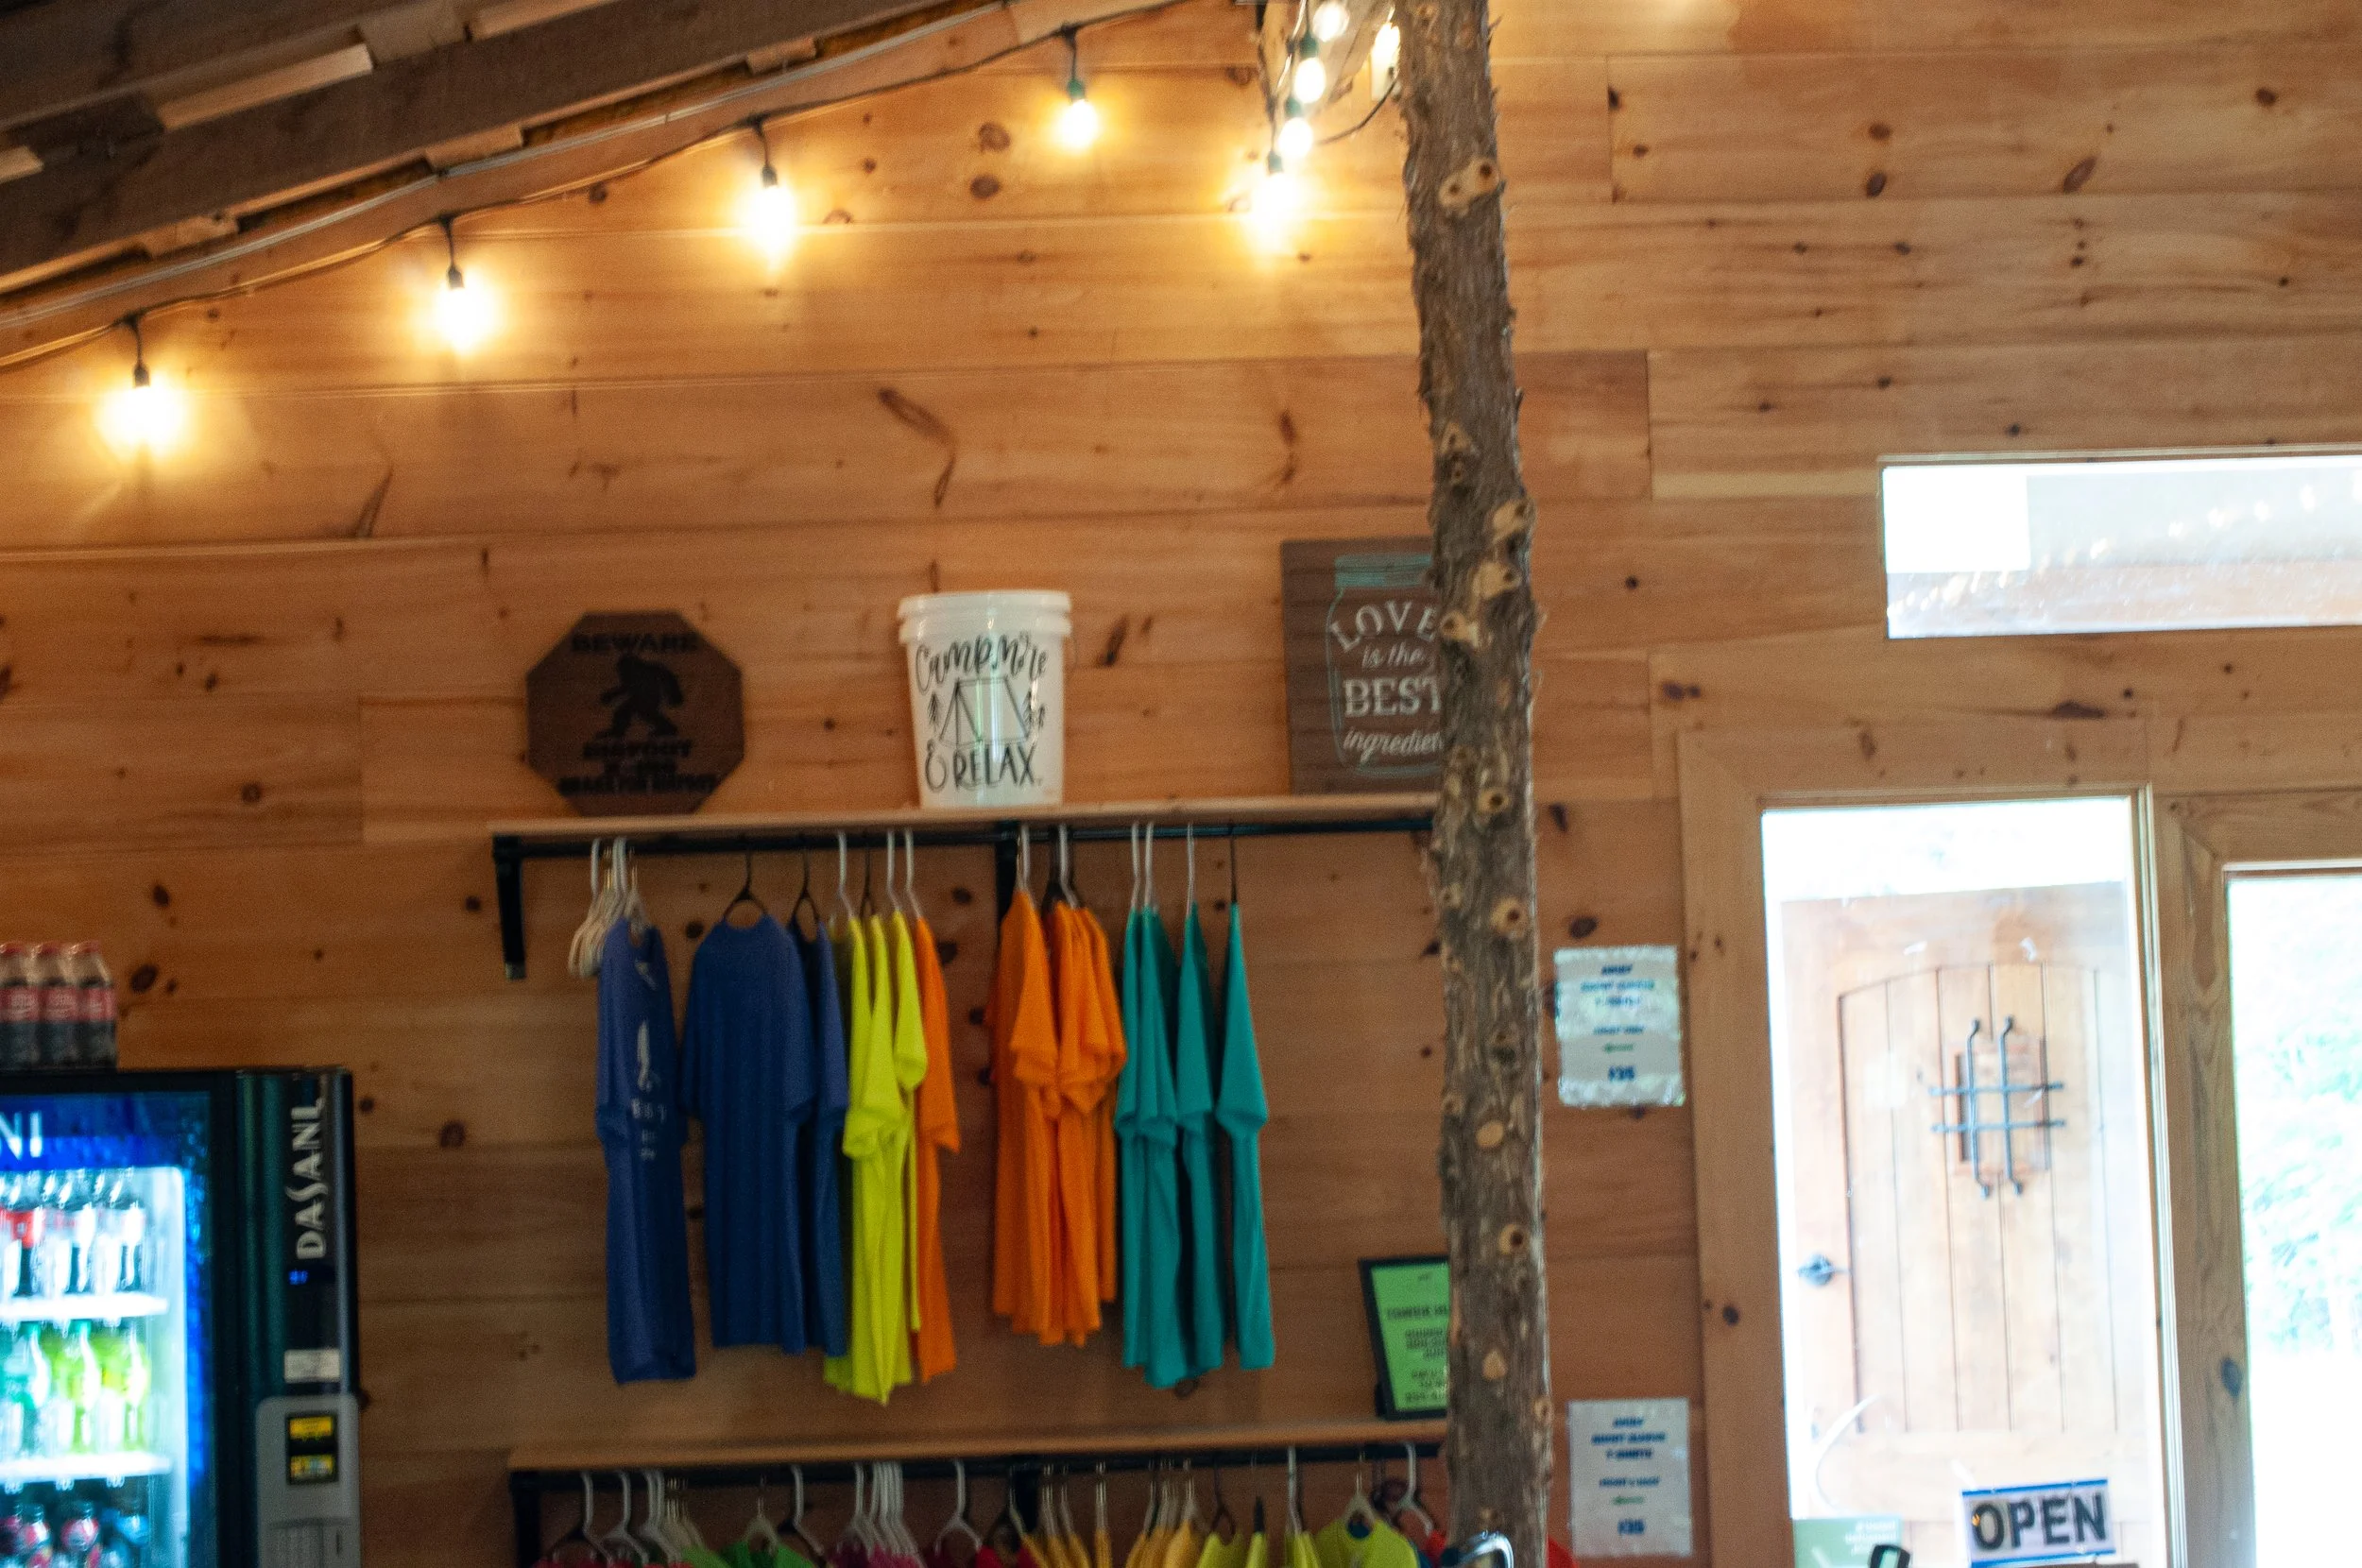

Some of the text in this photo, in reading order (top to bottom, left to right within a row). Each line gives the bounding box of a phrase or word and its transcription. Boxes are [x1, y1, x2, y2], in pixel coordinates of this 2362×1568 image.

[571, 633, 700, 652] BEWARE
[1329, 600, 1437, 653] LOVE
[1361, 641, 1428, 669] is the
[1343, 675, 1443, 718] BEST
[1970, 1494, 2107, 1552] OPEN
